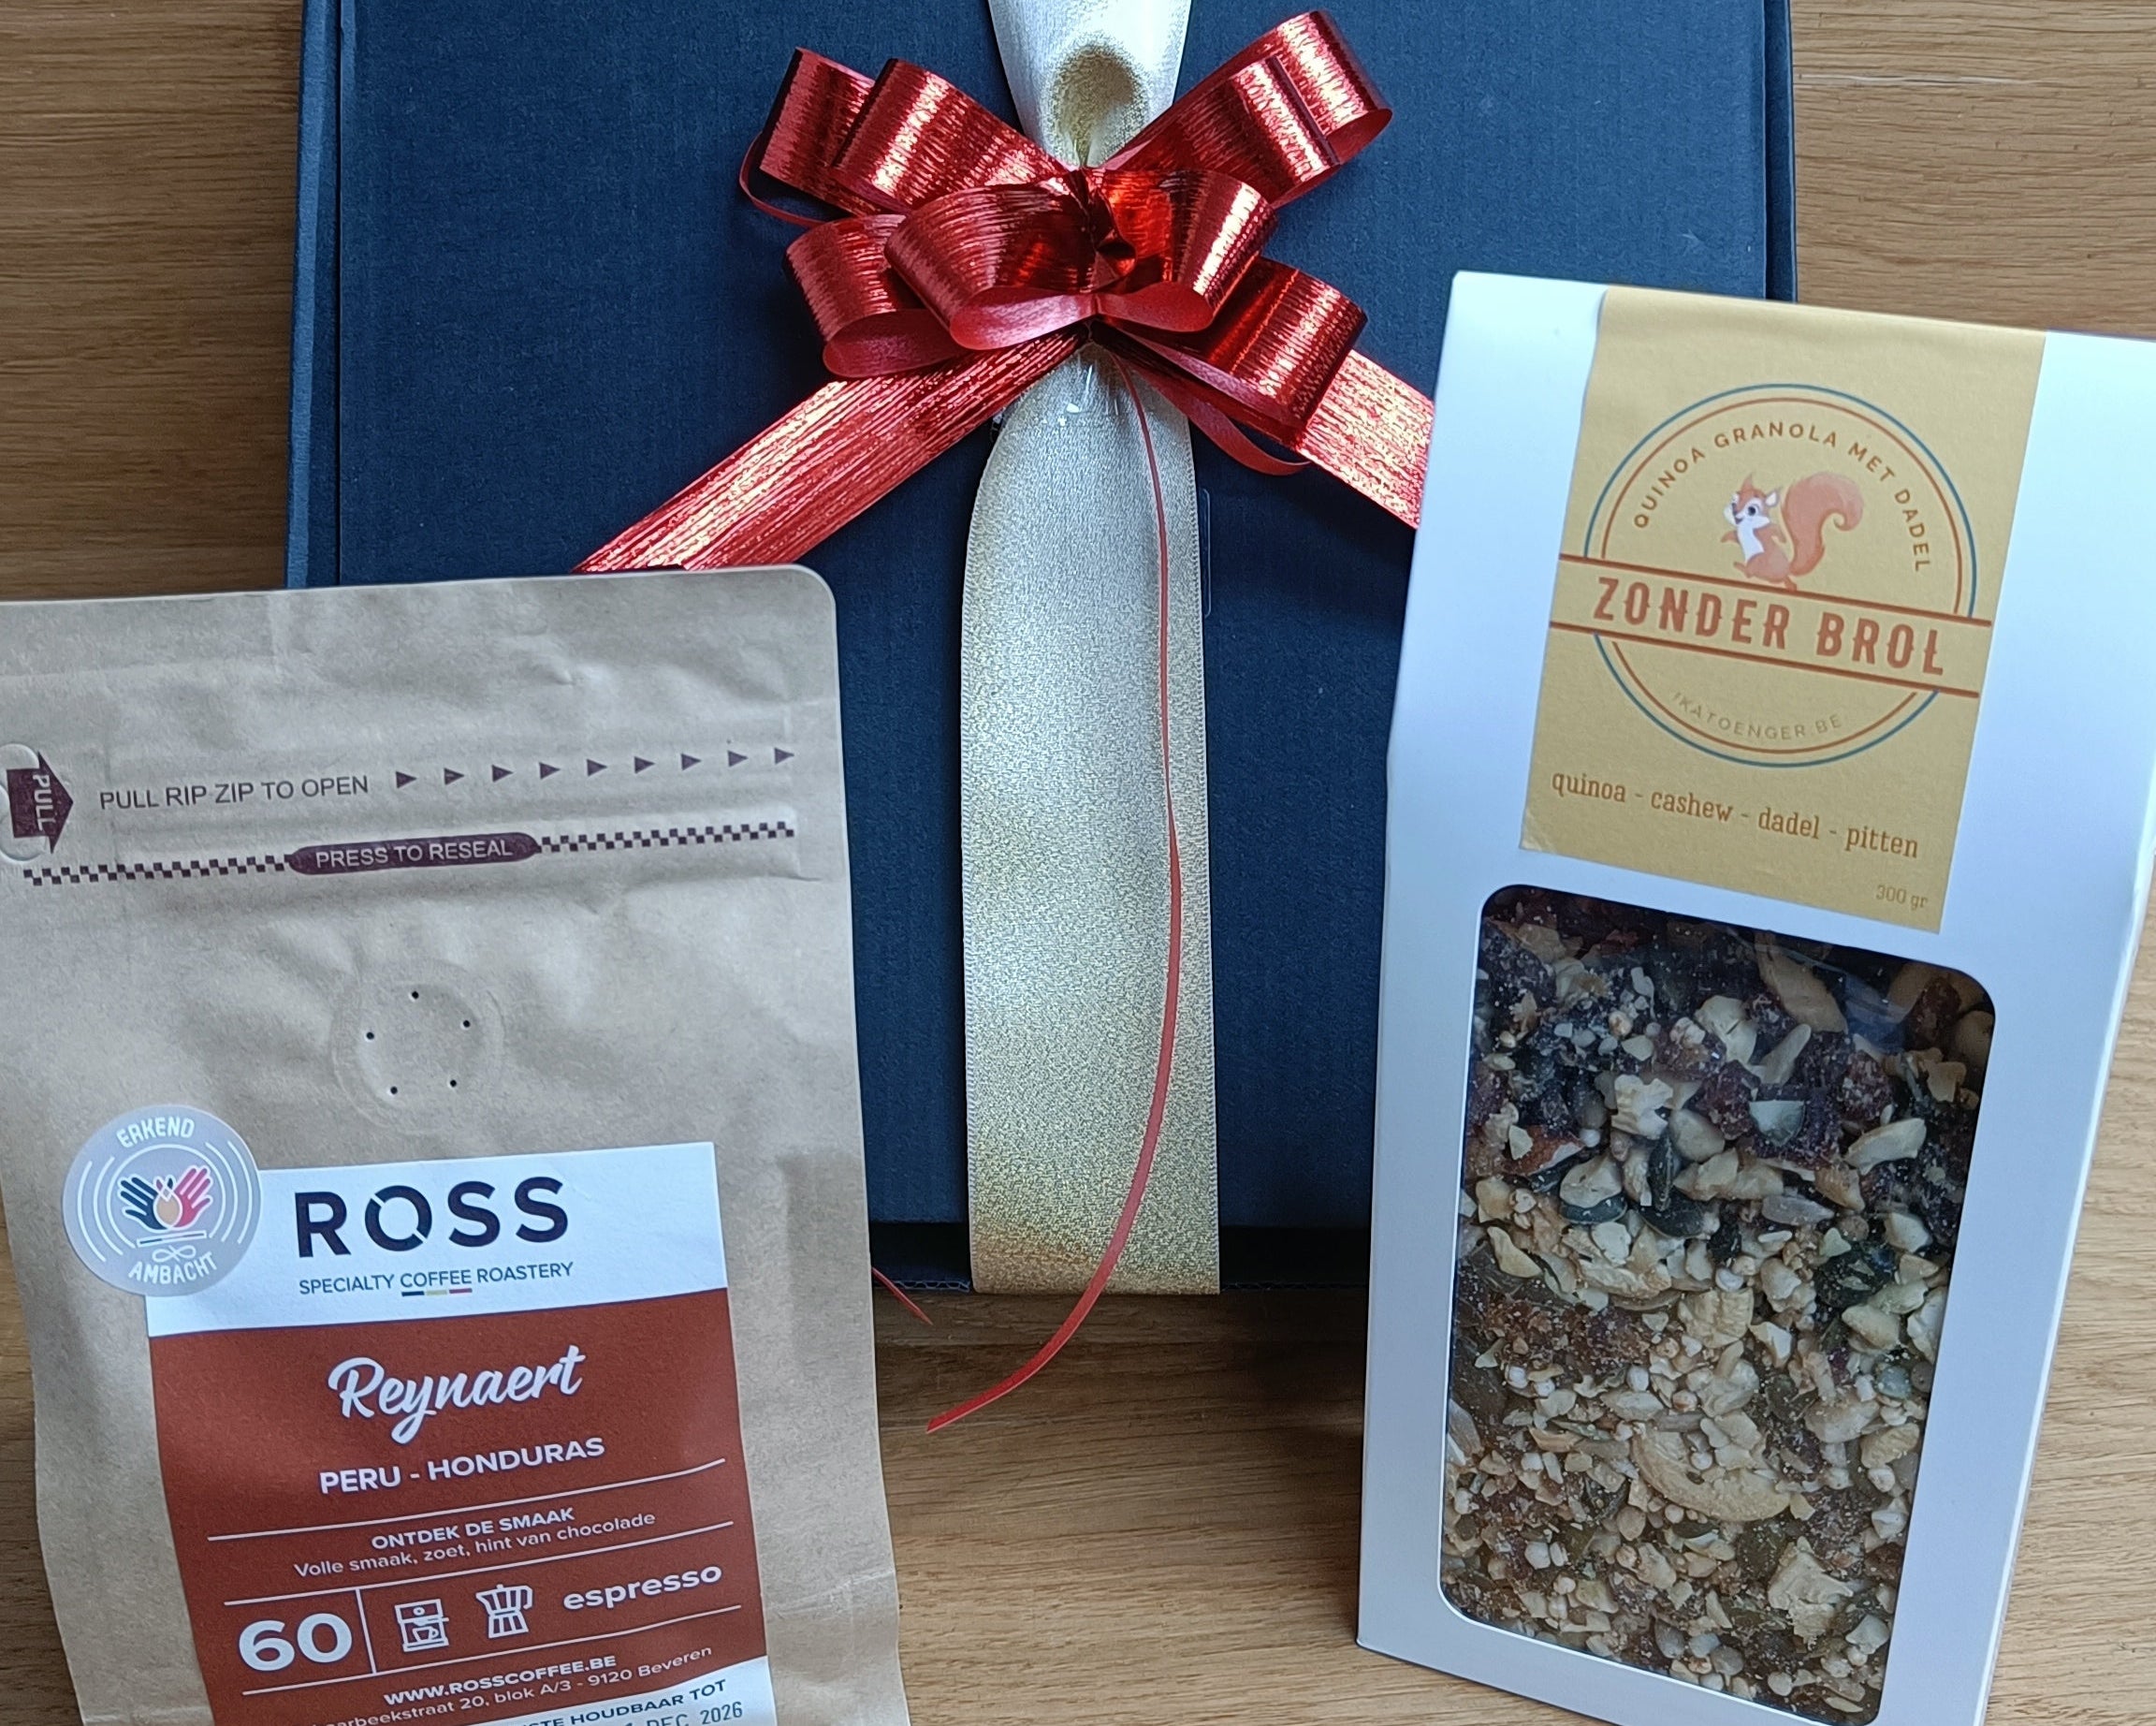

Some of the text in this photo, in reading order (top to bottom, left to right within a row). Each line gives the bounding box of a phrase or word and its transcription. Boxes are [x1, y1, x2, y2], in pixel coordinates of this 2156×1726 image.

[1634, 420, 1931, 573] QUINOA GRANOLA MET DADEL
[1593, 576, 1944, 676] ZONDER BROL
[33, 774, 56, 831] PULL
[100, 775, 369, 810] PULL RIP ZIP TO OPEN
[1551, 769, 1626, 803] quinoa
[1650, 789, 1734, 823] cashew
[1758, 806, 1820, 840] dadel
[1844, 824, 1919, 858] pitten
[316, 840, 513, 868] PRESS TO RESEAL
[1875, 884, 1928, 911] 300 gr
[116, 1117, 195, 1148] ERKEND
[295, 1177, 568, 1258] ROSS
[128, 1251, 217, 1284] AMBACHT
[299, 1262, 574, 1295] SPECIALTY COFFEE ROASTERY
[328, 1345, 586, 1444] Reynaert
[320, 1466, 401, 1494] PERU
[427, 1437, 605, 1481] HONDURAS
[294, 1514, 655, 1577] Volle smaak, zoet, hint van chocolade
[371, 1507, 575, 1549] ONTDEK DE SMAAK
[563, 1565, 722, 1609] espresso
[239, 1613, 353, 1672] 60
[383, 1655, 618, 1705] WWW.ROSSCOFFEE.BE
[459, 1695, 489, 1710] 20,
[494, 1686, 535, 1704] blok
[540, 1679, 572, 1695] A/3
[588, 1669, 633, 1686] 9120
[637, 1646, 712, 1677] Beveren
[570, 1694, 684, 1725] HOUDBAAR
[689, 1679, 726, 1701] TOT
[699, 1701, 743, 1725] 2026
